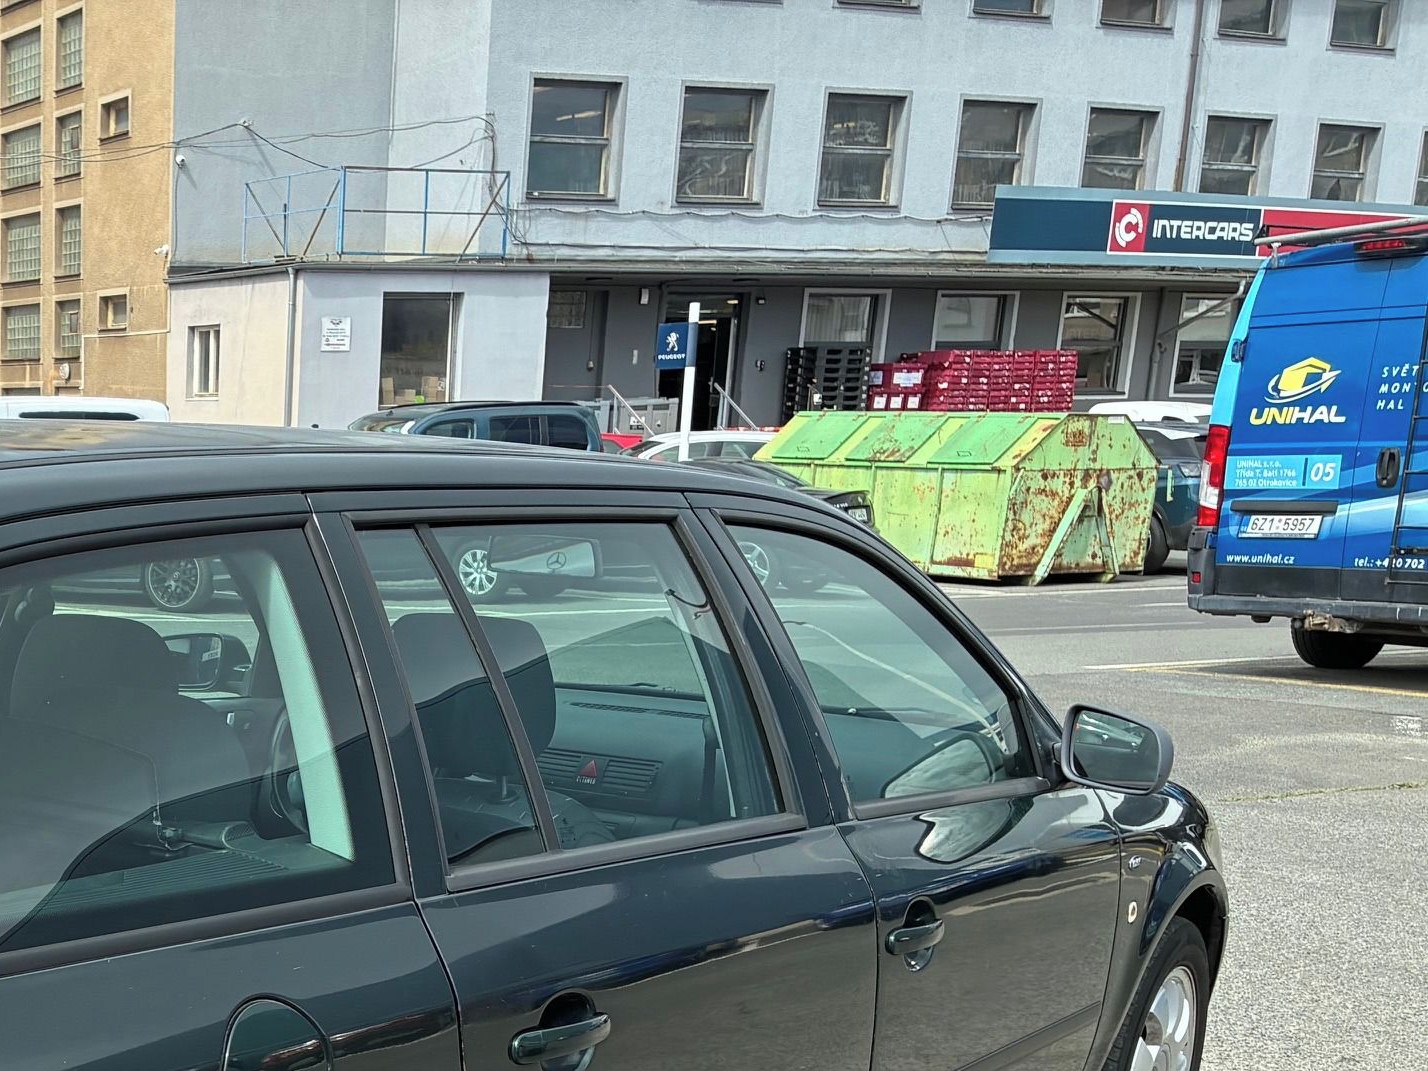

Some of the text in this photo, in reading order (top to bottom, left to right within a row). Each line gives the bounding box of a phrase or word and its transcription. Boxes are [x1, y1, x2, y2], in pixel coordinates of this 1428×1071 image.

[1153, 219, 1254, 241] INTERCARS
[1376, 399, 1404, 410] HAL
[1249, 405, 1346, 425] UNIHAL
[1236, 459, 1262, 468] UNIHAL
[1310, 462, 1336, 482] 05
[1250, 517, 1275, 531] 6Z1
[1282, 518, 1315, 532] 5957
[1226, 553, 1295, 564] www.unihal.cz
[1404, 558, 1425, 569] 702
